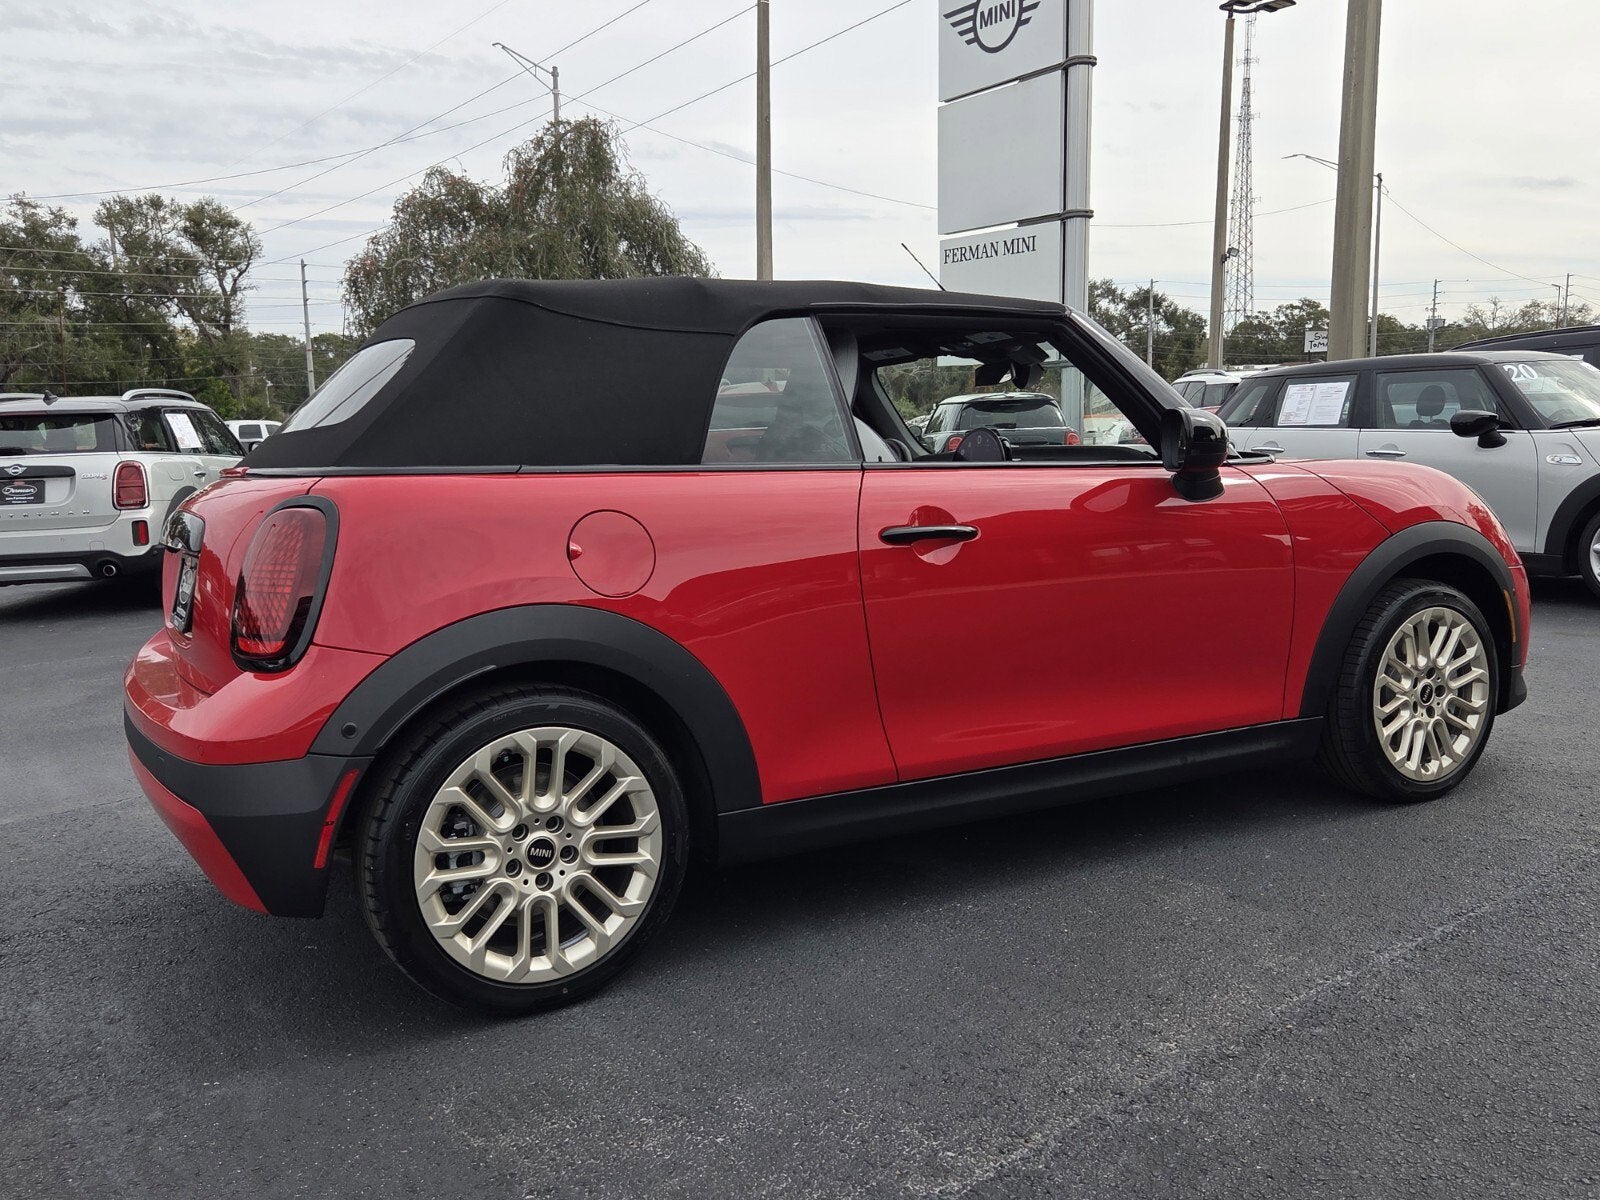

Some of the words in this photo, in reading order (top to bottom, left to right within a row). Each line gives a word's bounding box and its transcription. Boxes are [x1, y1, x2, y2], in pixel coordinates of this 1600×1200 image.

[980, 0, 1015, 29] MINI
[943, 241, 999, 264] FERMAN
[1002, 235, 1037, 256] MINI
[1503, 363, 1538, 383] 20
[529, 847, 552, 858] MINI
